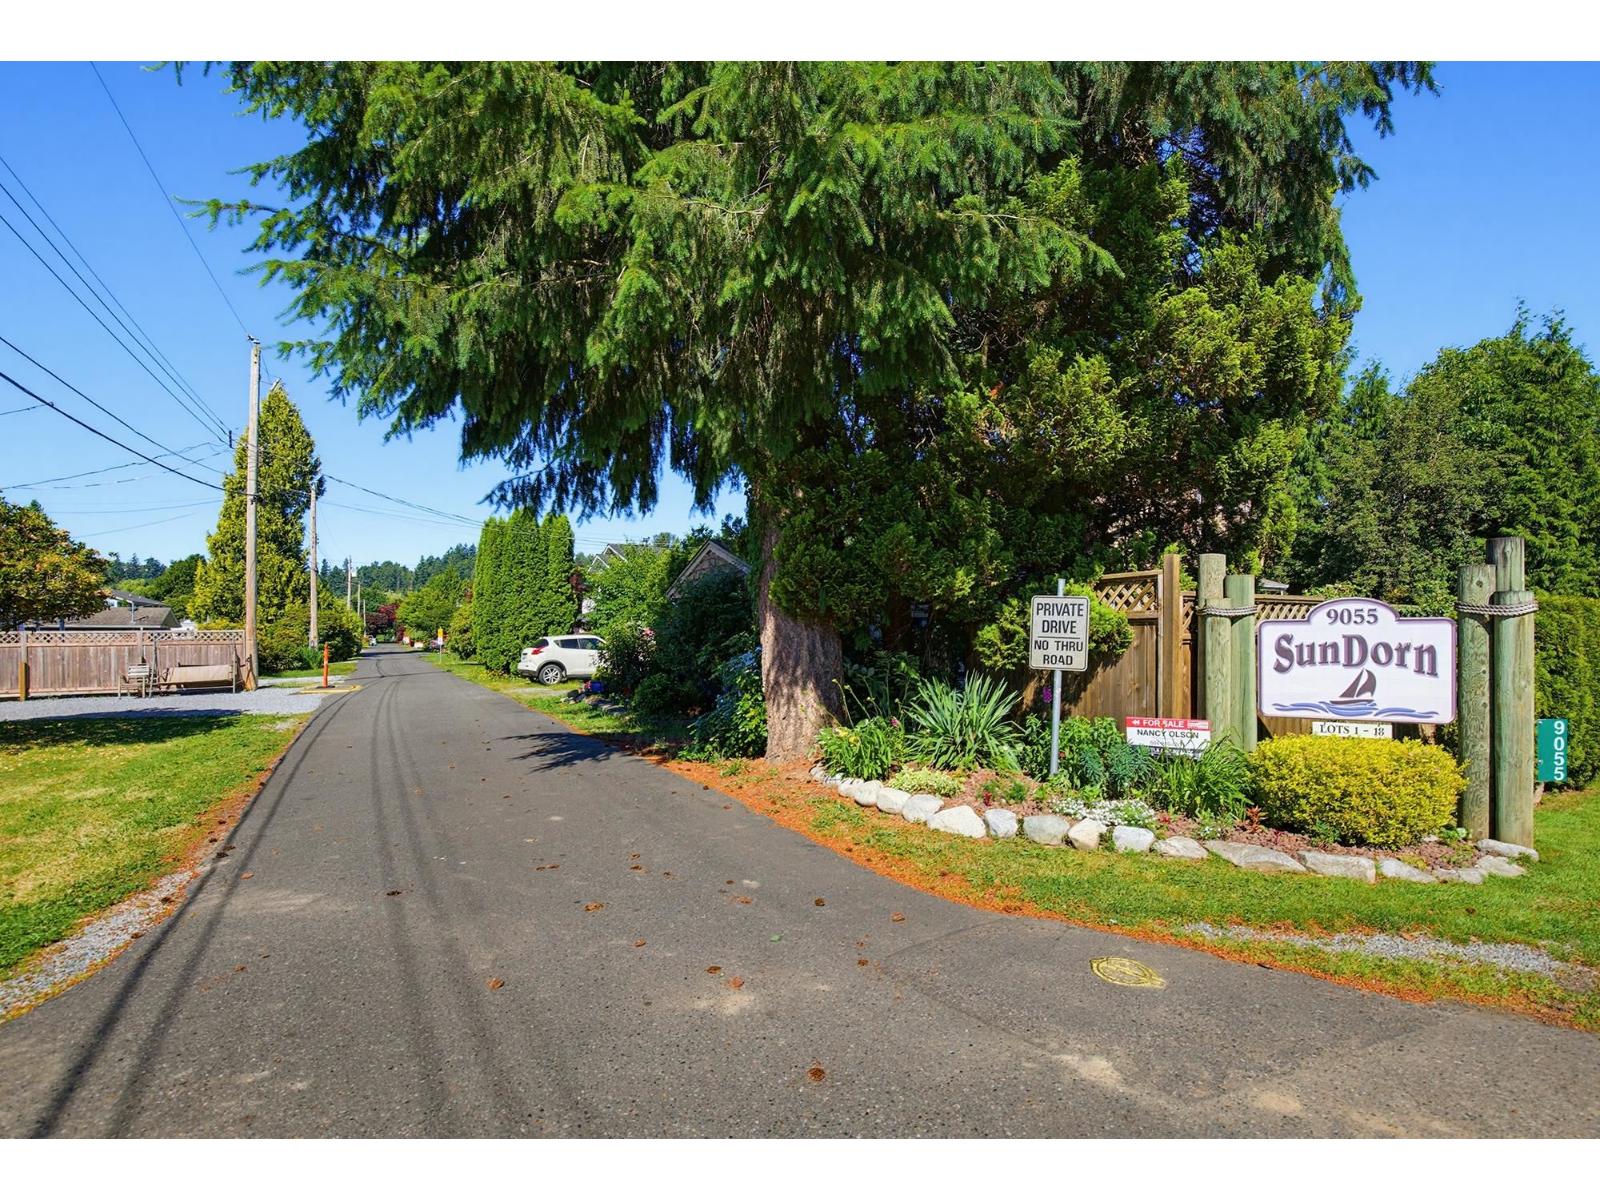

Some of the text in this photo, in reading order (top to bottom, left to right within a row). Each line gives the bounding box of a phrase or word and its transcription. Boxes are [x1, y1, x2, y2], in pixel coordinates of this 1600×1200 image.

[1036, 602, 1084, 617] PRIVATE
[1326, 608, 1379, 625] 9055
[1041, 620, 1077, 634] DRIVE
[1034, 640, 1084, 652] NO THRU
[1042, 654, 1074, 666] ROAD
[1273, 633, 1439, 678] SunDorn
[1142, 719, 1160, 727] FOR
[1136, 729, 1199, 739] NANCY OLSON
[1319, 724, 1350, 735] LOTS
[1373, 727, 1385, 737] 18
[1553, 720, 1566, 781] 9055
